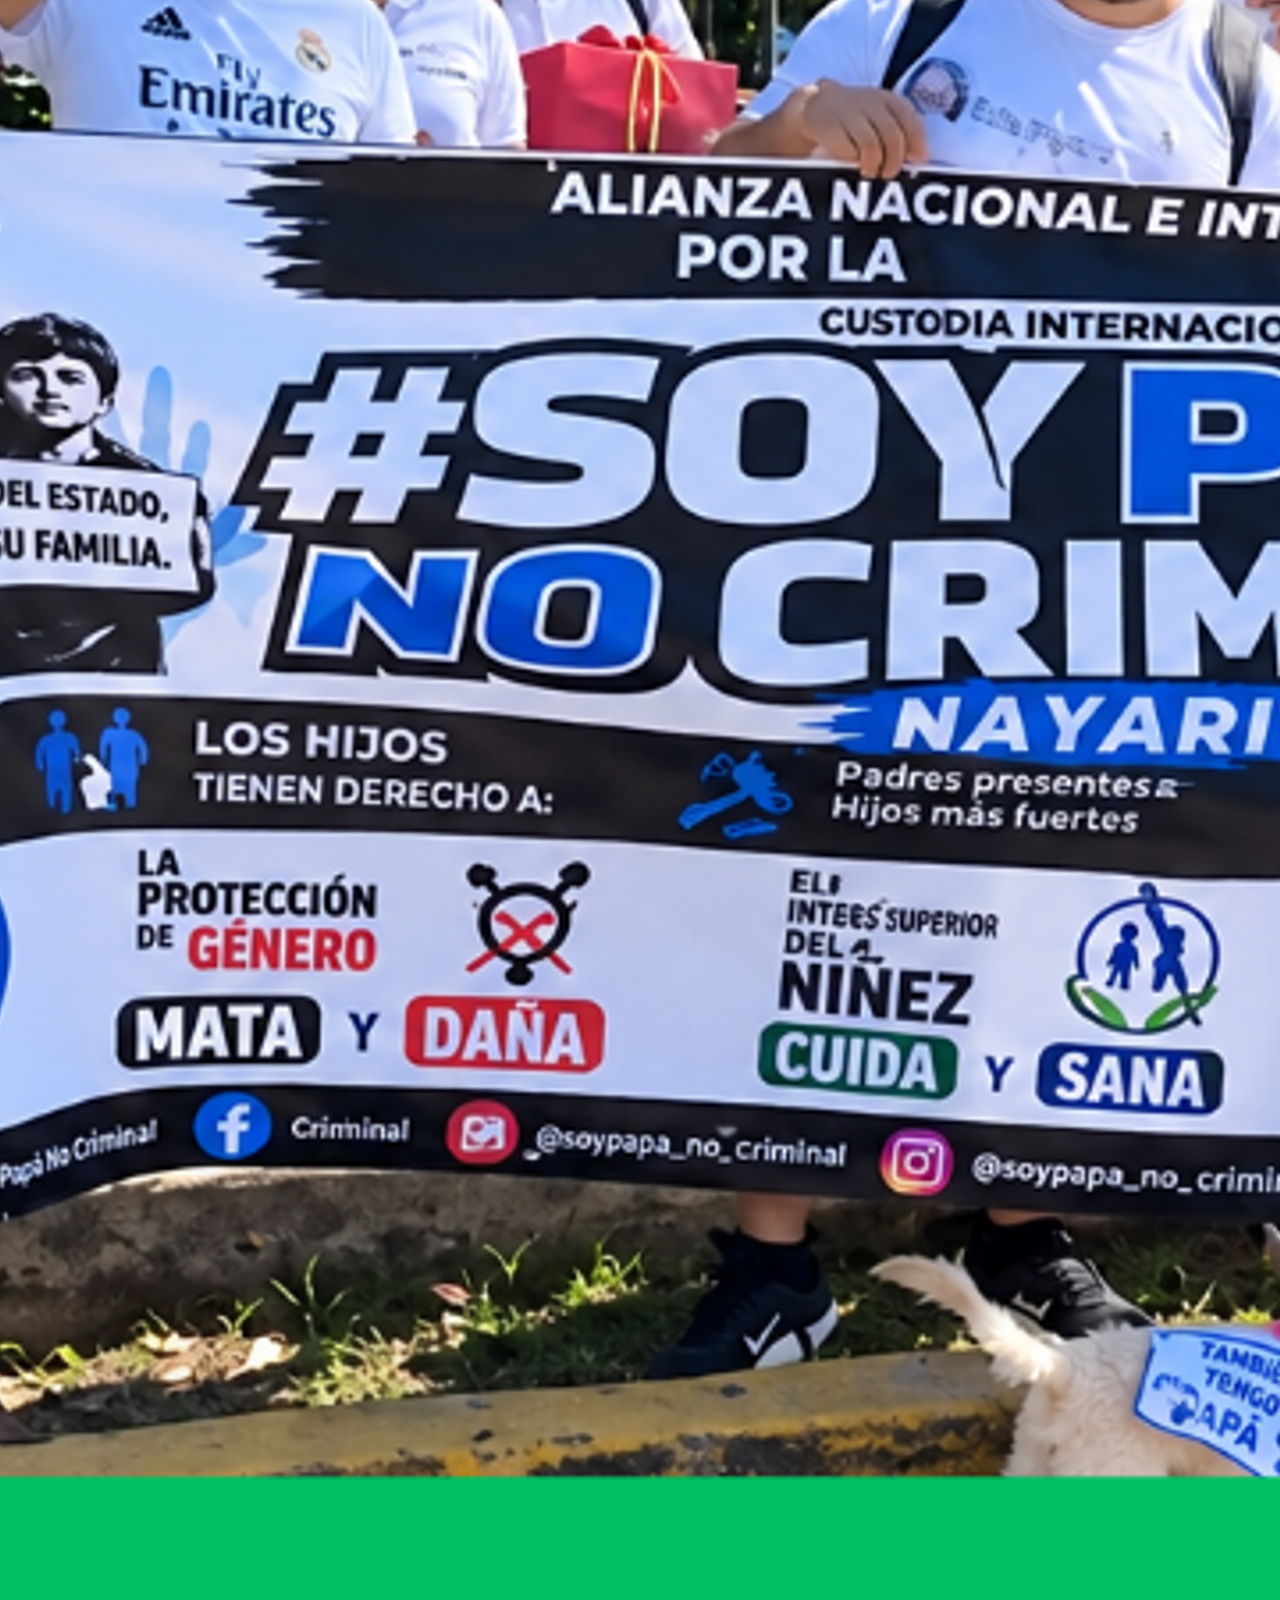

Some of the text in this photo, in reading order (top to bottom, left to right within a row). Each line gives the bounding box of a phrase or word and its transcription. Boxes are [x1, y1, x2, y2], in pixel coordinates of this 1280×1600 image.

[217, 52, 261, 90] Fly
[139, 64, 336, 137] Emirates
[551, 171, 812, 219] ALIANZA
[830, 178, 1130, 233] NACIONAL
[1146, 197, 1184, 236] E
[676, 234, 906, 283] POR LA
[820, 307, 1013, 339] CUSTODIA
[253, 353, 1070, 526] #SOY
[48, 483, 169, 523] ESTADO,
[35, 528, 172, 570] FAMILIA.
[286, 543, 658, 674] NO
[195, 720, 449, 765] LOS HIJOS
[194, 772, 554, 815] TIENEN DERECHO A:
[836, 760, 962, 791] Padres
[831, 795, 1139, 834] Hijos más fuertes
[137, 848, 180, 876] LA
[137, 874, 378, 918] PROTECCIÓN
[783, 928, 844, 959] DEL
[884, 906, 999, 939] SUPERIOR
[137, 918, 377, 972] DE GÉNERO
[778, 956, 974, 1026] NIÑEZ
[135, 1000, 586, 1066] MATA Y DAÑA
[774, 1030, 1206, 1109] CUIDA Y SANA
[45, 1145, 71, 1172] No
[73, 1118, 159, 1160] Criminal
[291, 1116, 410, 1143] Criminal
[534, 1123, 848, 1167] @soypapa_no_criminal
